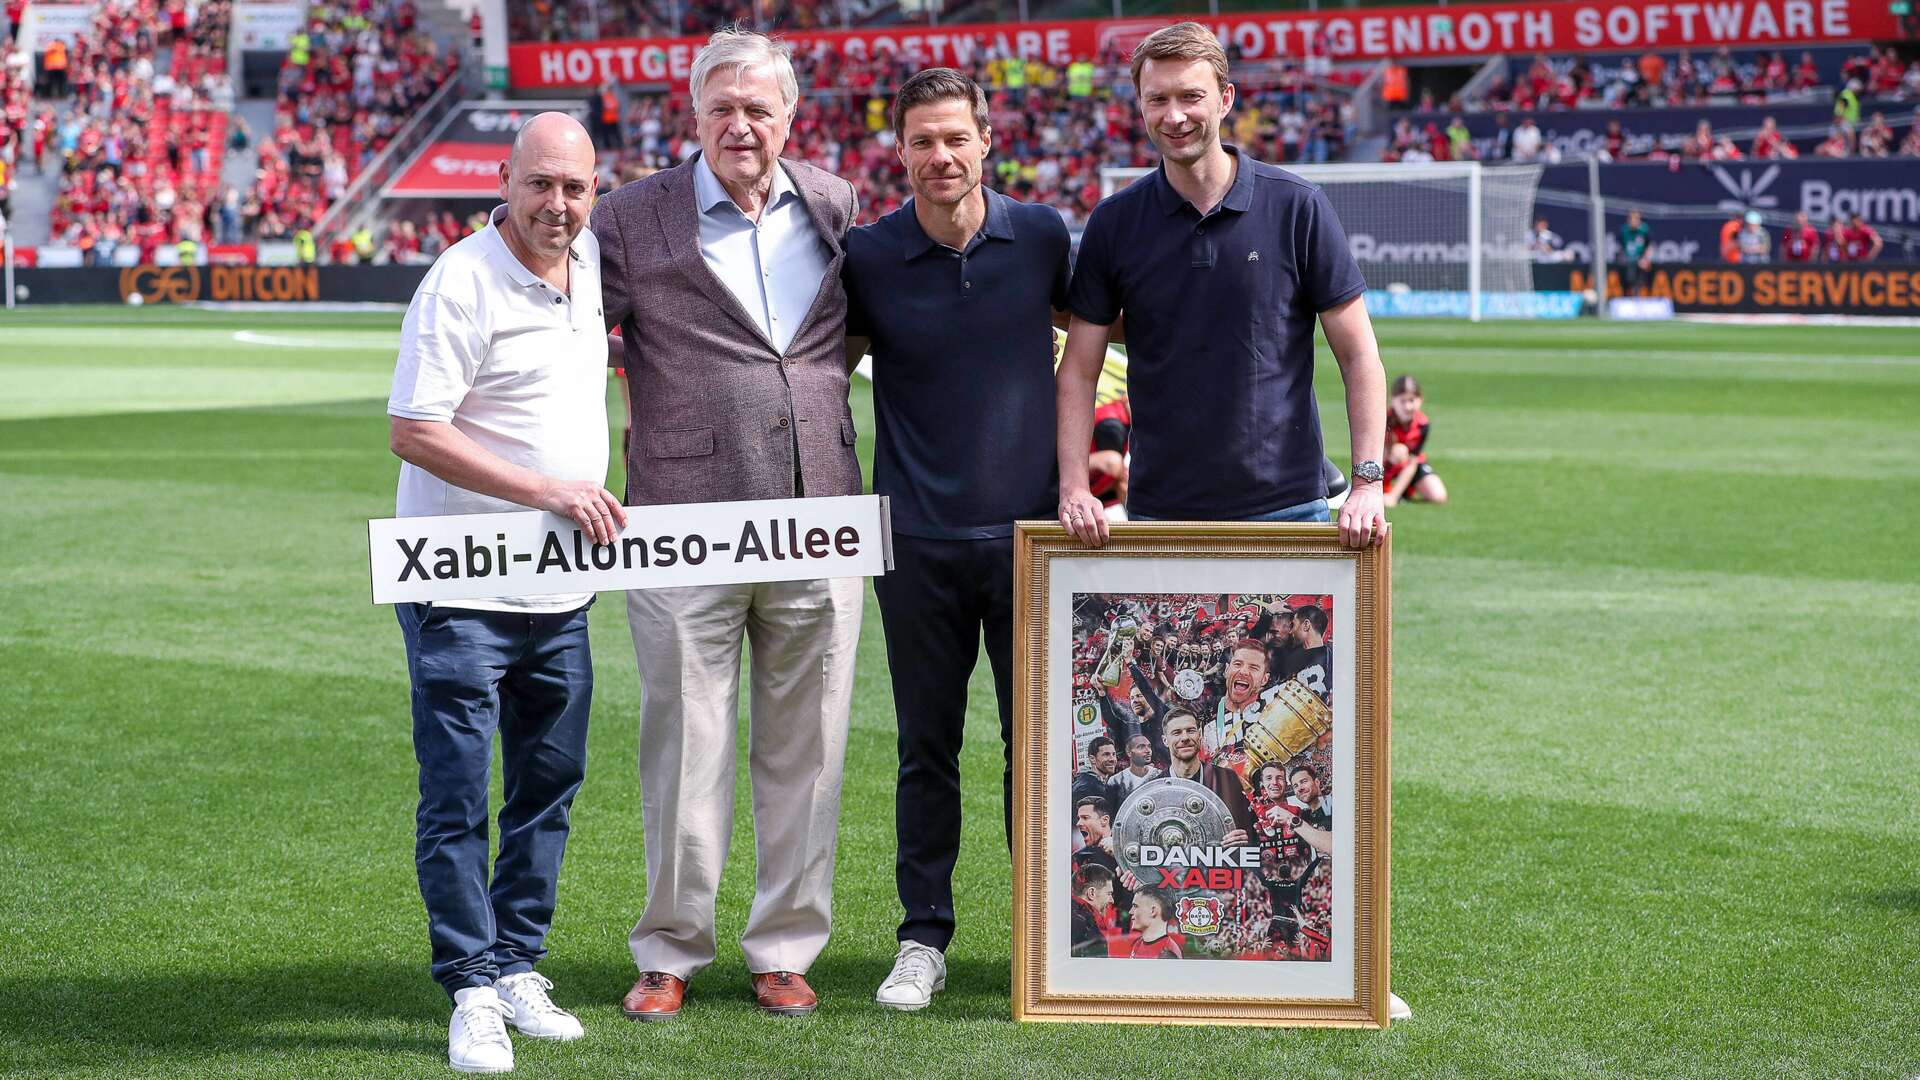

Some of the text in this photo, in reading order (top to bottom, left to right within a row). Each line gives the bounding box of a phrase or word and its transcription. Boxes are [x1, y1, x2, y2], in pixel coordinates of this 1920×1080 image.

[1574, 0, 1850, 46] SOFTWARE
[211, 266, 320, 301] DITCON
[396, 518, 860, 582] Xabi-Alonso-Allee
[1140, 845, 1260, 868] DANKE
[1157, 867, 1242, 890] XABI
